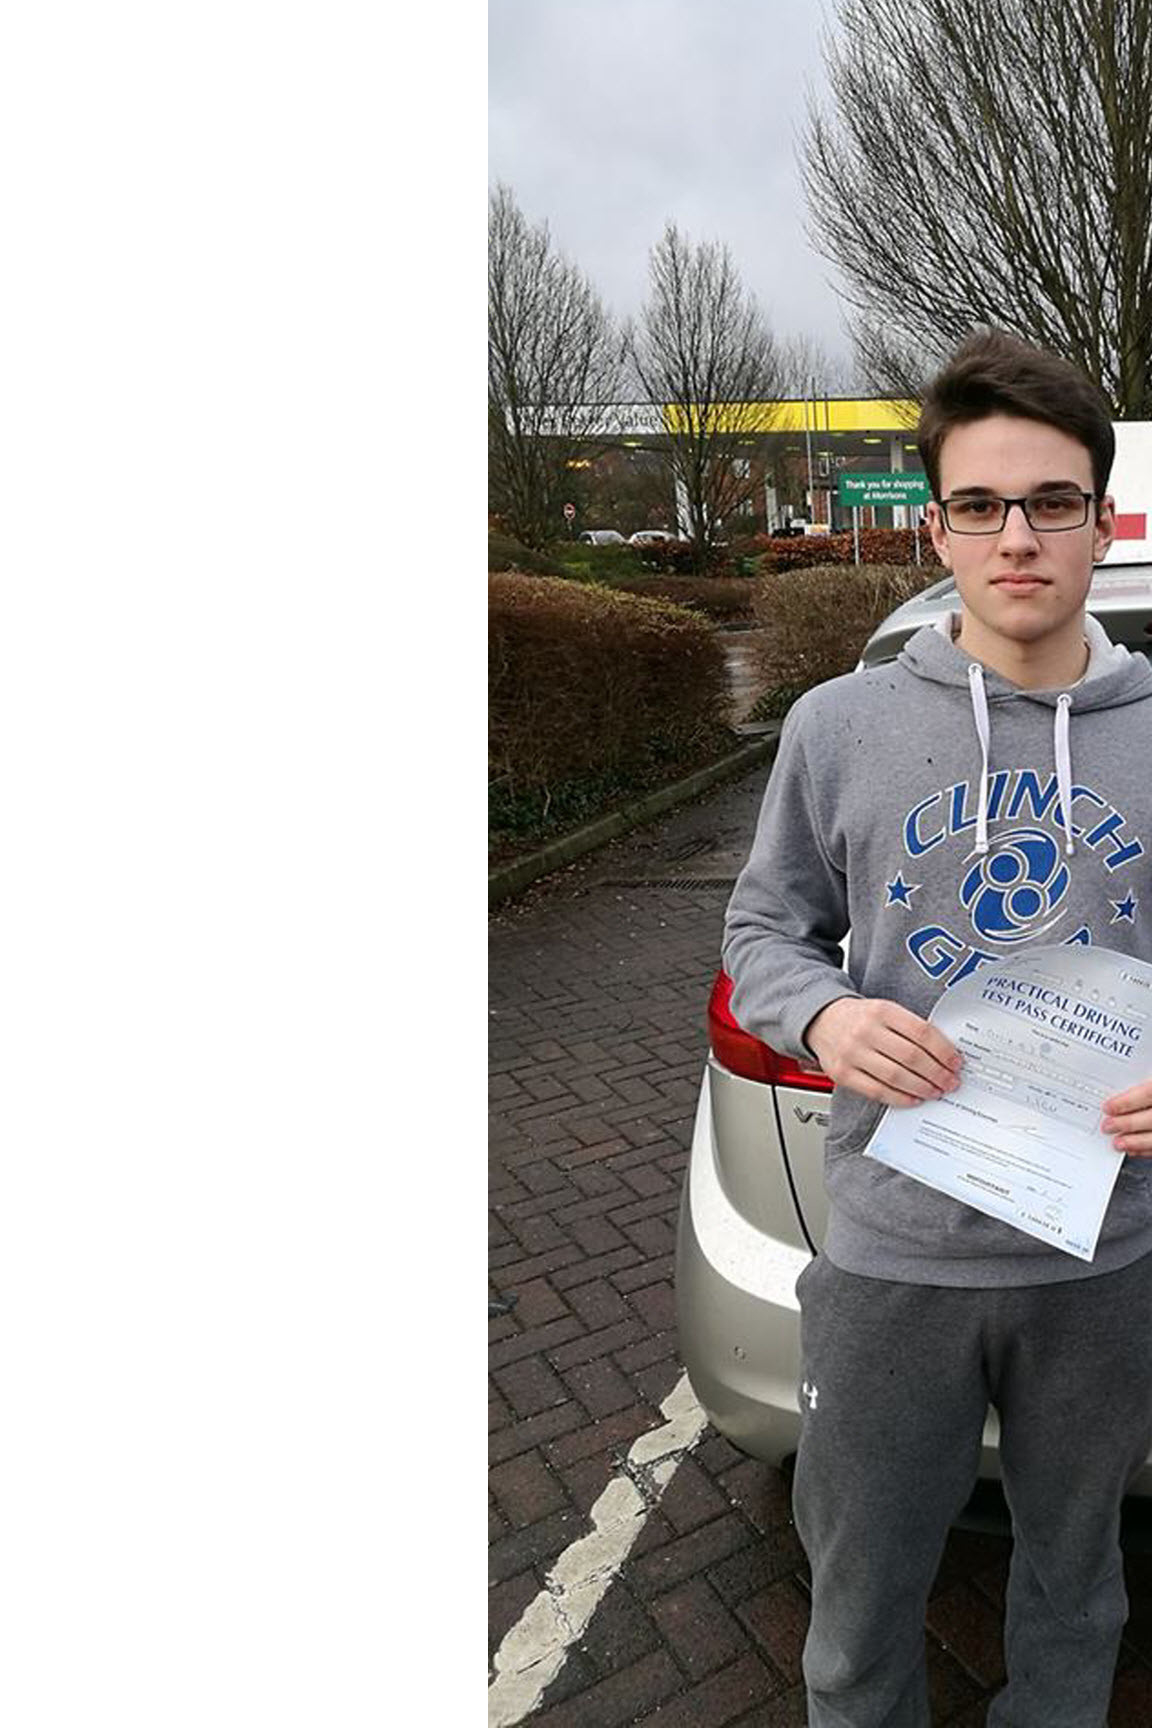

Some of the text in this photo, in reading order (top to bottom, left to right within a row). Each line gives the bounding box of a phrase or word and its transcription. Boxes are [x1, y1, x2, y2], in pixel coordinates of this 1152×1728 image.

[846, 480, 925, 491] Thank you for shopping
[872, 491, 907, 500] Morrisons
[903, 769, 1144, 873] CLINCH
[981, 989, 1012, 1007] TEST
[1014, 999, 1047, 1022] PASS
[1050, 1014, 1135, 1059] CERTIFICATE
[986, 976, 1070, 1012] PRACTICAL
[1073, 1002, 1143, 1042] DRIVING
